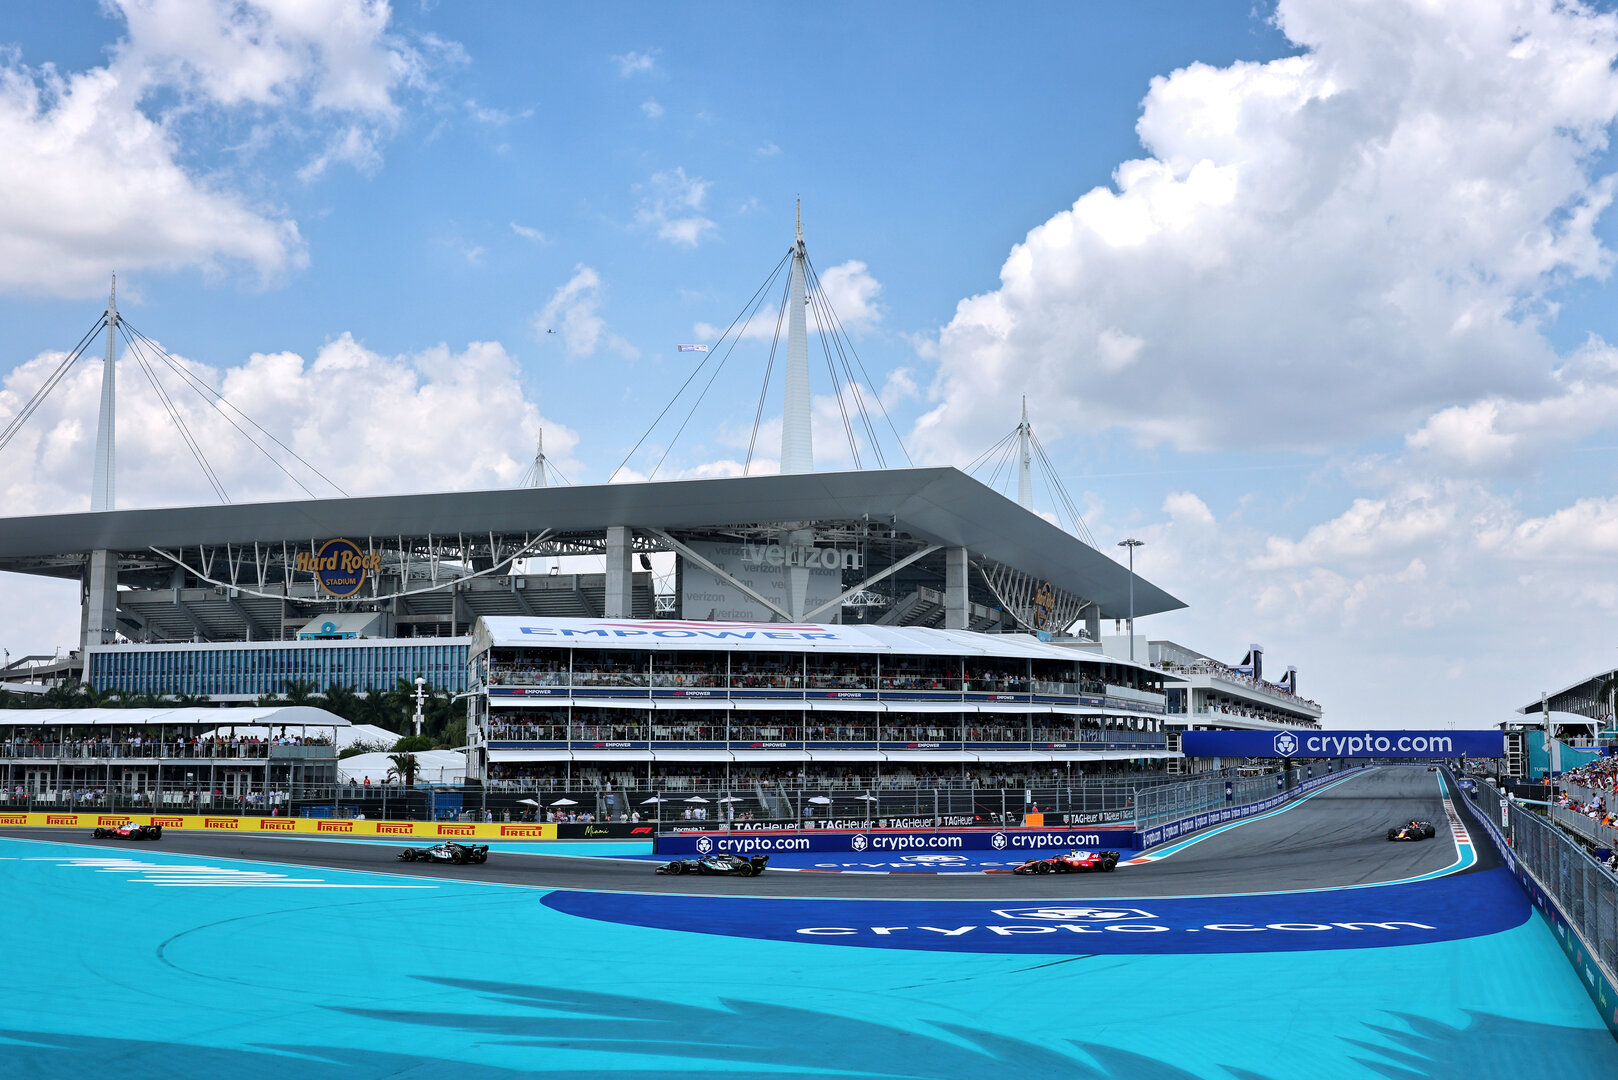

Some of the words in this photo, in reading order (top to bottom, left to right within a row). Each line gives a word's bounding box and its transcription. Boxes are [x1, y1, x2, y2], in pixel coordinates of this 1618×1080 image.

[297, 550, 339, 571] Hard
[341, 549, 382, 574] Rock
[747, 543, 859, 570] verizon
[326, 578, 356, 586] STADIUM
[686, 592, 725, 602] verizon
[519, 626, 842, 641] EMPOWER
[1306, 733, 1453, 755] crypto.com
[47, 815, 78, 825] PIRELLI
[204, 818, 239, 829] PIRELLI
[260, 819, 295, 830] PIRELLI
[317, 821, 353, 832] PIRELLI
[376, 823, 413, 834] PIRELLI
[437, 824, 476, 836] PIRELLI
[500, 825, 543, 837] PIRELLI
[584, 825, 609, 837] Miami
[718, 837, 810, 852] crypto.com
[872, 835, 962, 850] crypto.com
[1012, 833, 1100, 848] crypto.com
[796, 920, 1437, 936] crypto.com
